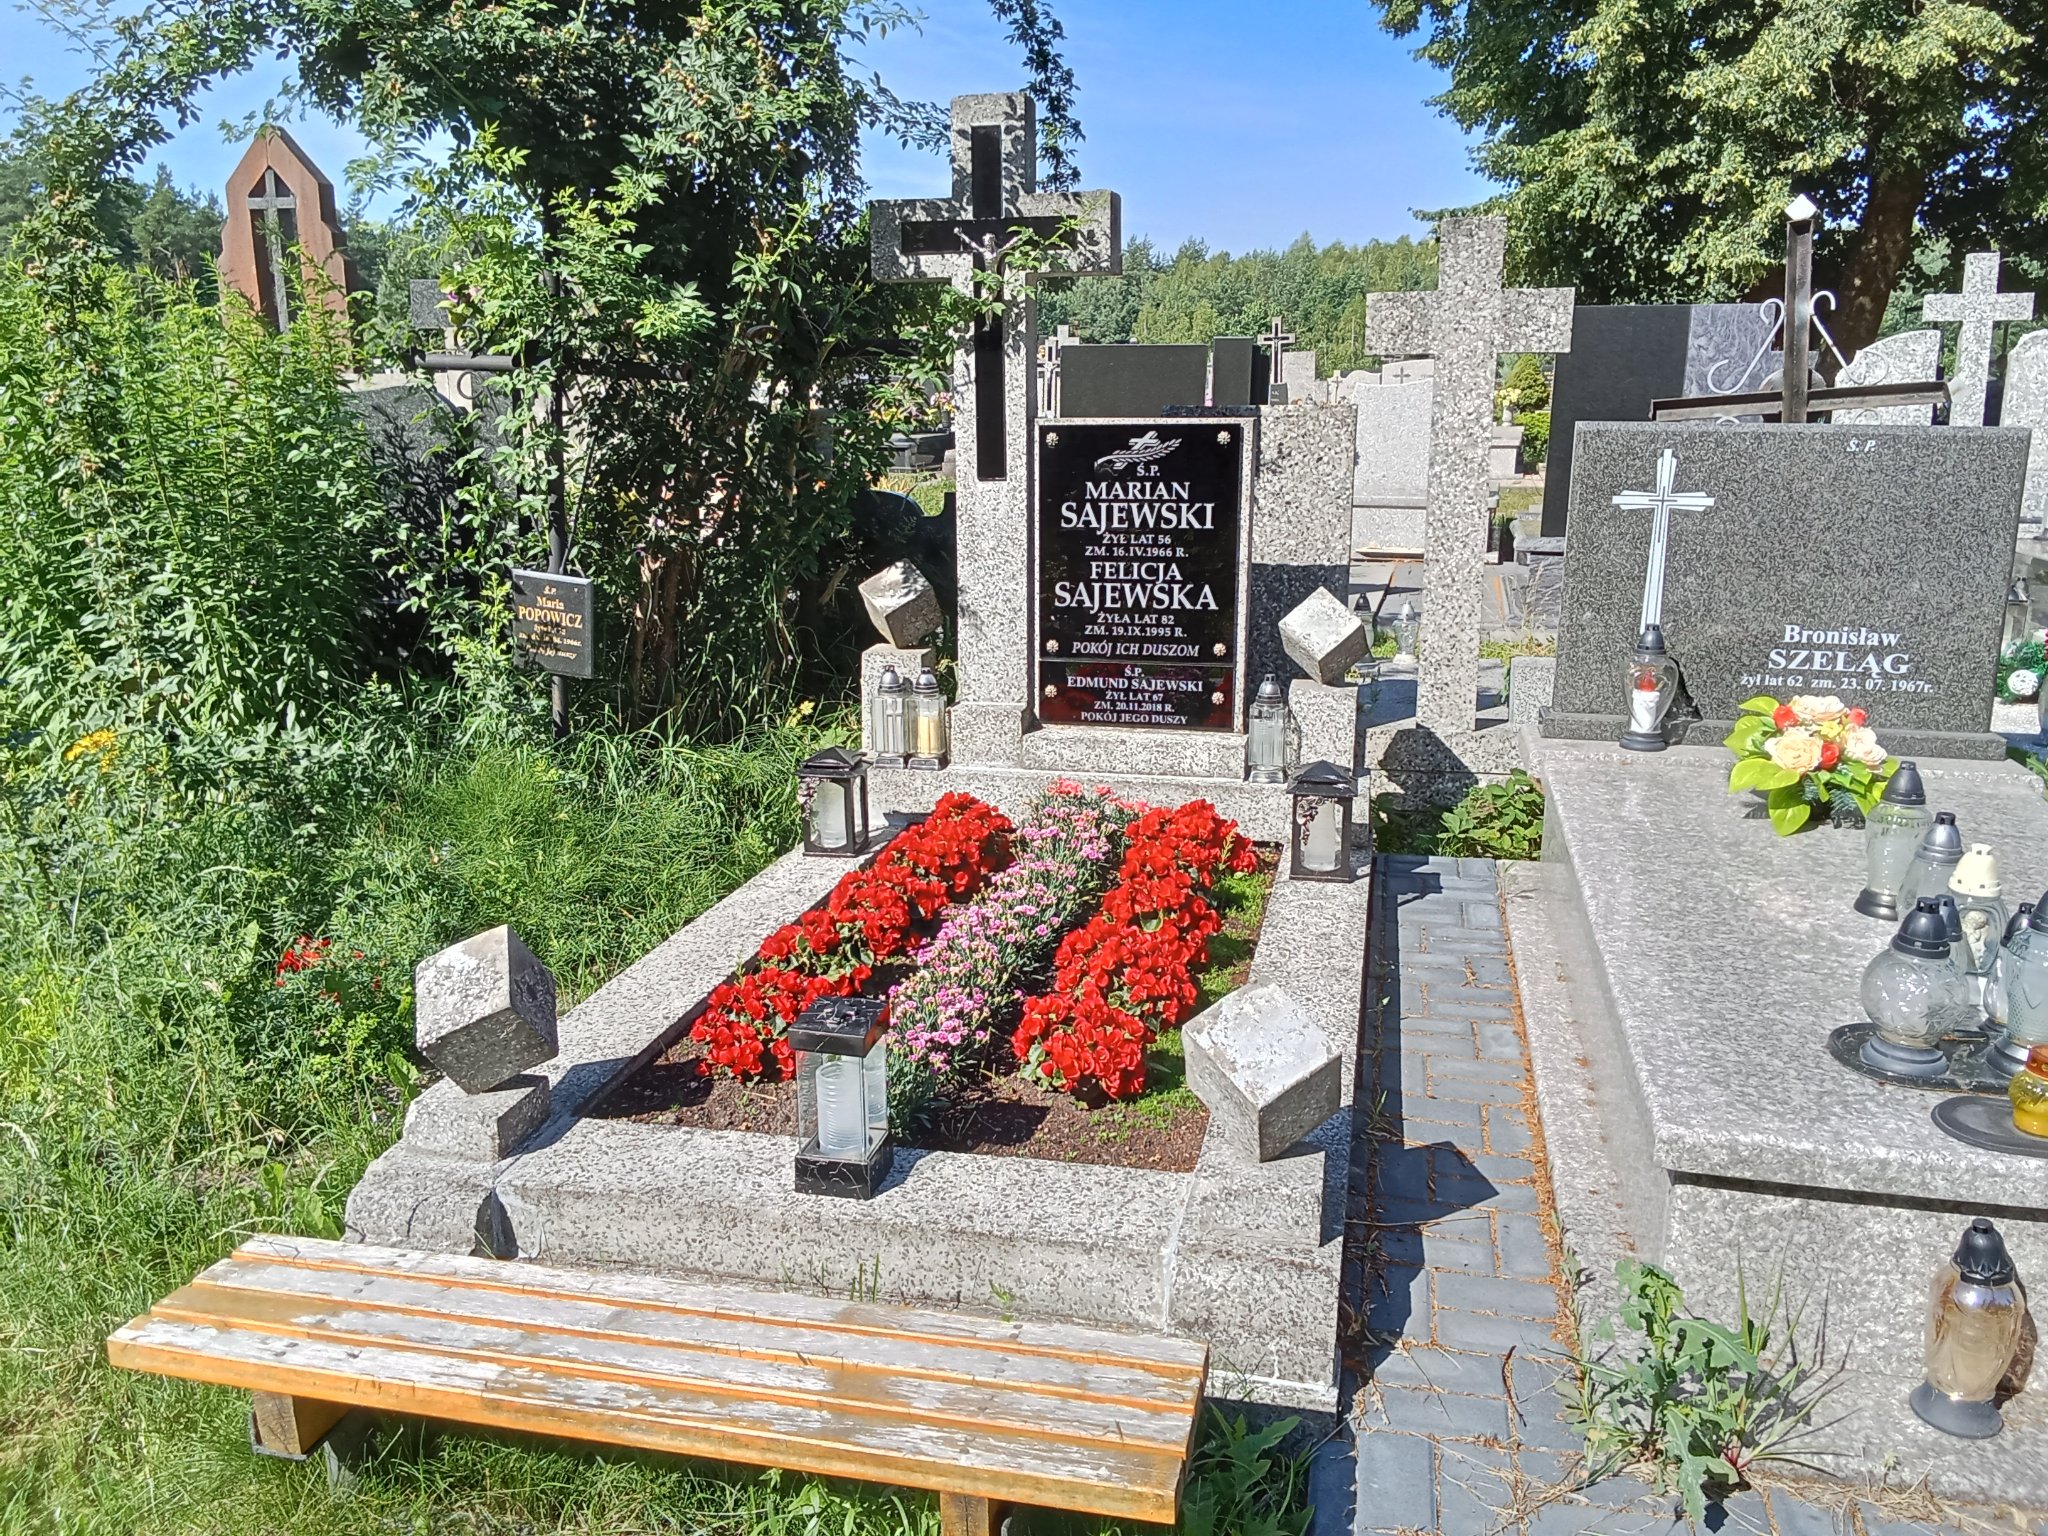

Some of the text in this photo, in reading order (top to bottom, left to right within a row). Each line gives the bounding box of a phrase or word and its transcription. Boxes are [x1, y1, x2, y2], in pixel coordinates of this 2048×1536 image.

[1136, 463, 1161, 477] Ś.P.
[1084, 481, 1191, 500] MARIAN
[1060, 502, 1215, 535] SAJEWSKI
[1102, 532, 1172, 545] ŻYŁ LAT 56
[1084, 546, 1189, 558] ZM. 16.IV.1966 R.
[1089, 561, 1184, 583] FELICJA
[536, 596, 565, 610] Maria
[1054, 581, 1219, 614] SAJEWSKA
[518, 606, 583, 629] POPOWICZ
[1097, 611, 1175, 625] ŻYŁA LAT 82
[1084, 625, 1188, 638] ZM. 19.IX.1995 R.
[1783, 624, 1901, 647] Bronisław
[1072, 639, 1200, 657] POKÓJ ICH DUSZOM
[1124, 665, 1145, 677] Ś.P.
[1768, 649, 1910, 679] SZELĄG
[1067, 676, 1203, 692] EDMUND SAJEWSKI
[1764, 674, 1783, 686] lat
[1787, 676, 1803, 687] 62
[1811, 679, 1836, 689] zm.
[1841, 677, 1861, 690] 23.
[1865, 678, 1886, 691] 07.
[1891, 680, 1934, 693] 1967r.
[1105, 690, 1163, 702] ŻYŁ LAT 67
[1094, 701, 1175, 712] ZM. 20.11.2018 R.
[1081, 711, 1188, 725] POKÓJ JEGO DUSZY
